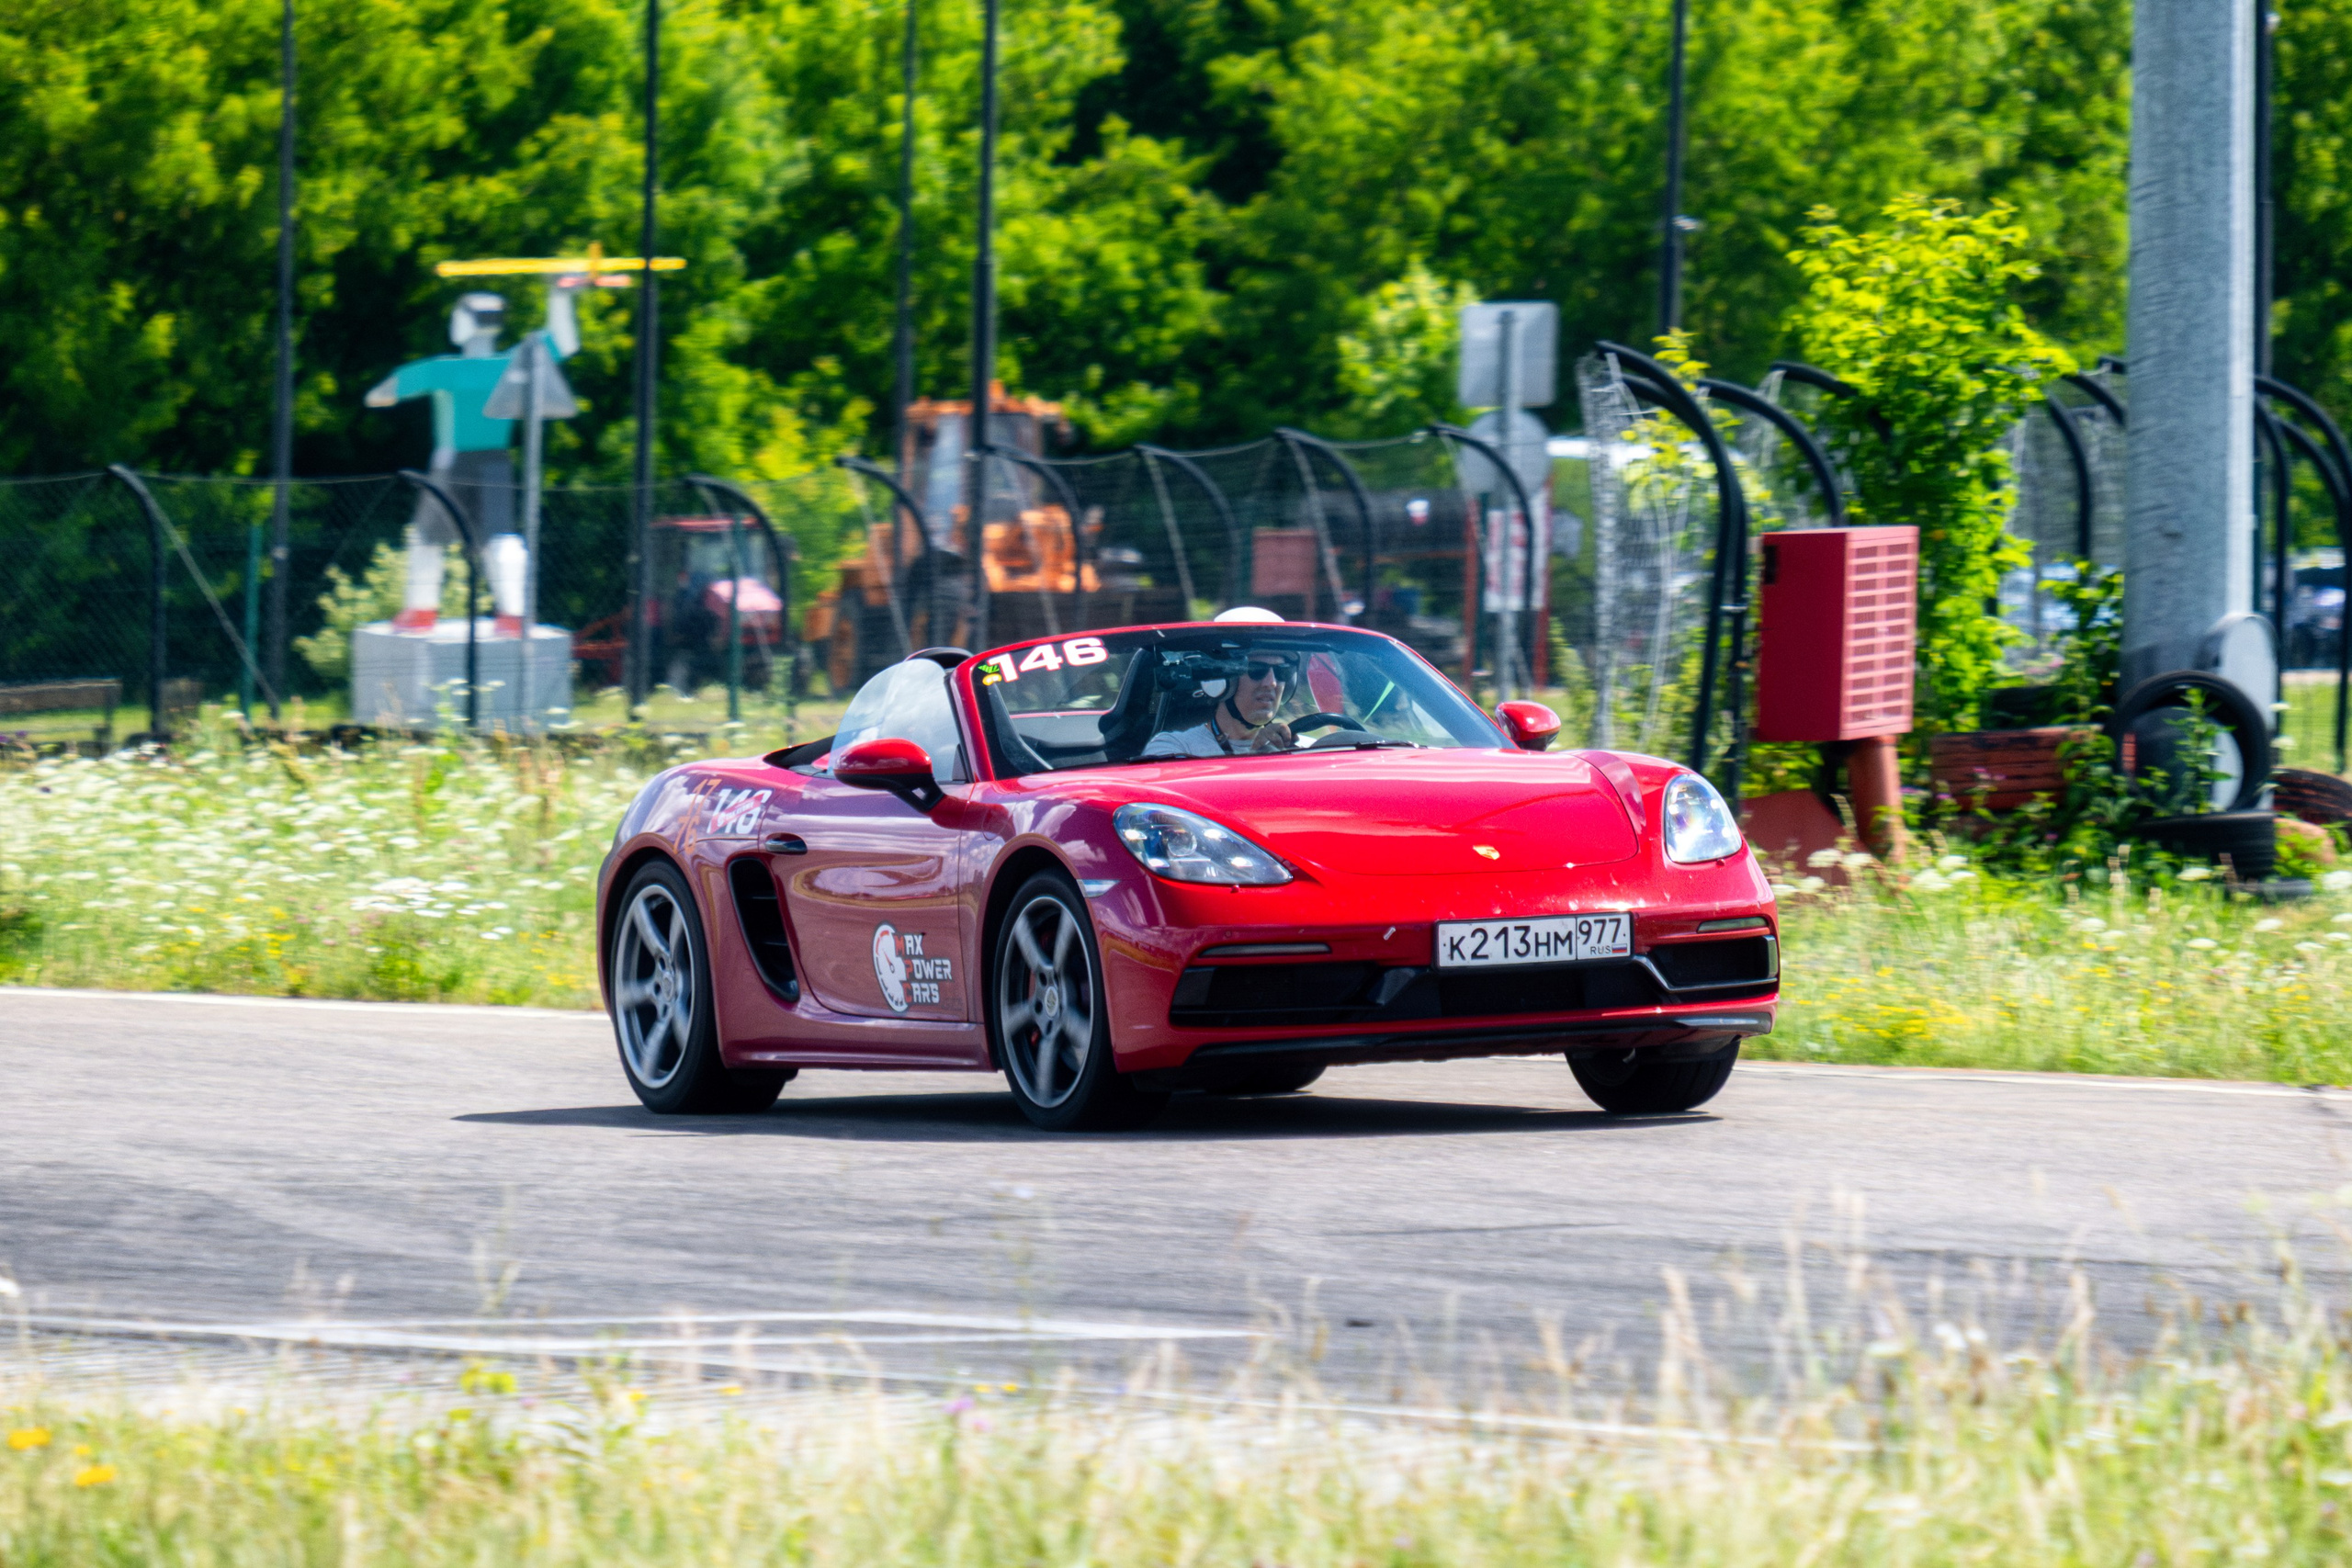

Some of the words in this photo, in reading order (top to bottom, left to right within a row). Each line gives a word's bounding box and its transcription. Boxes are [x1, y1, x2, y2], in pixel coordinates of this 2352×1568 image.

[987, 637, 1108, 682] 146
[706, 788, 773, 835] 146
[1577, 918, 1622, 945] 977
[894, 933, 924, 956] MAX
[1589, 945, 1611, 955] RUS
[903, 958, 953, 980] POWER
[903, 982, 940, 1004] CARS
